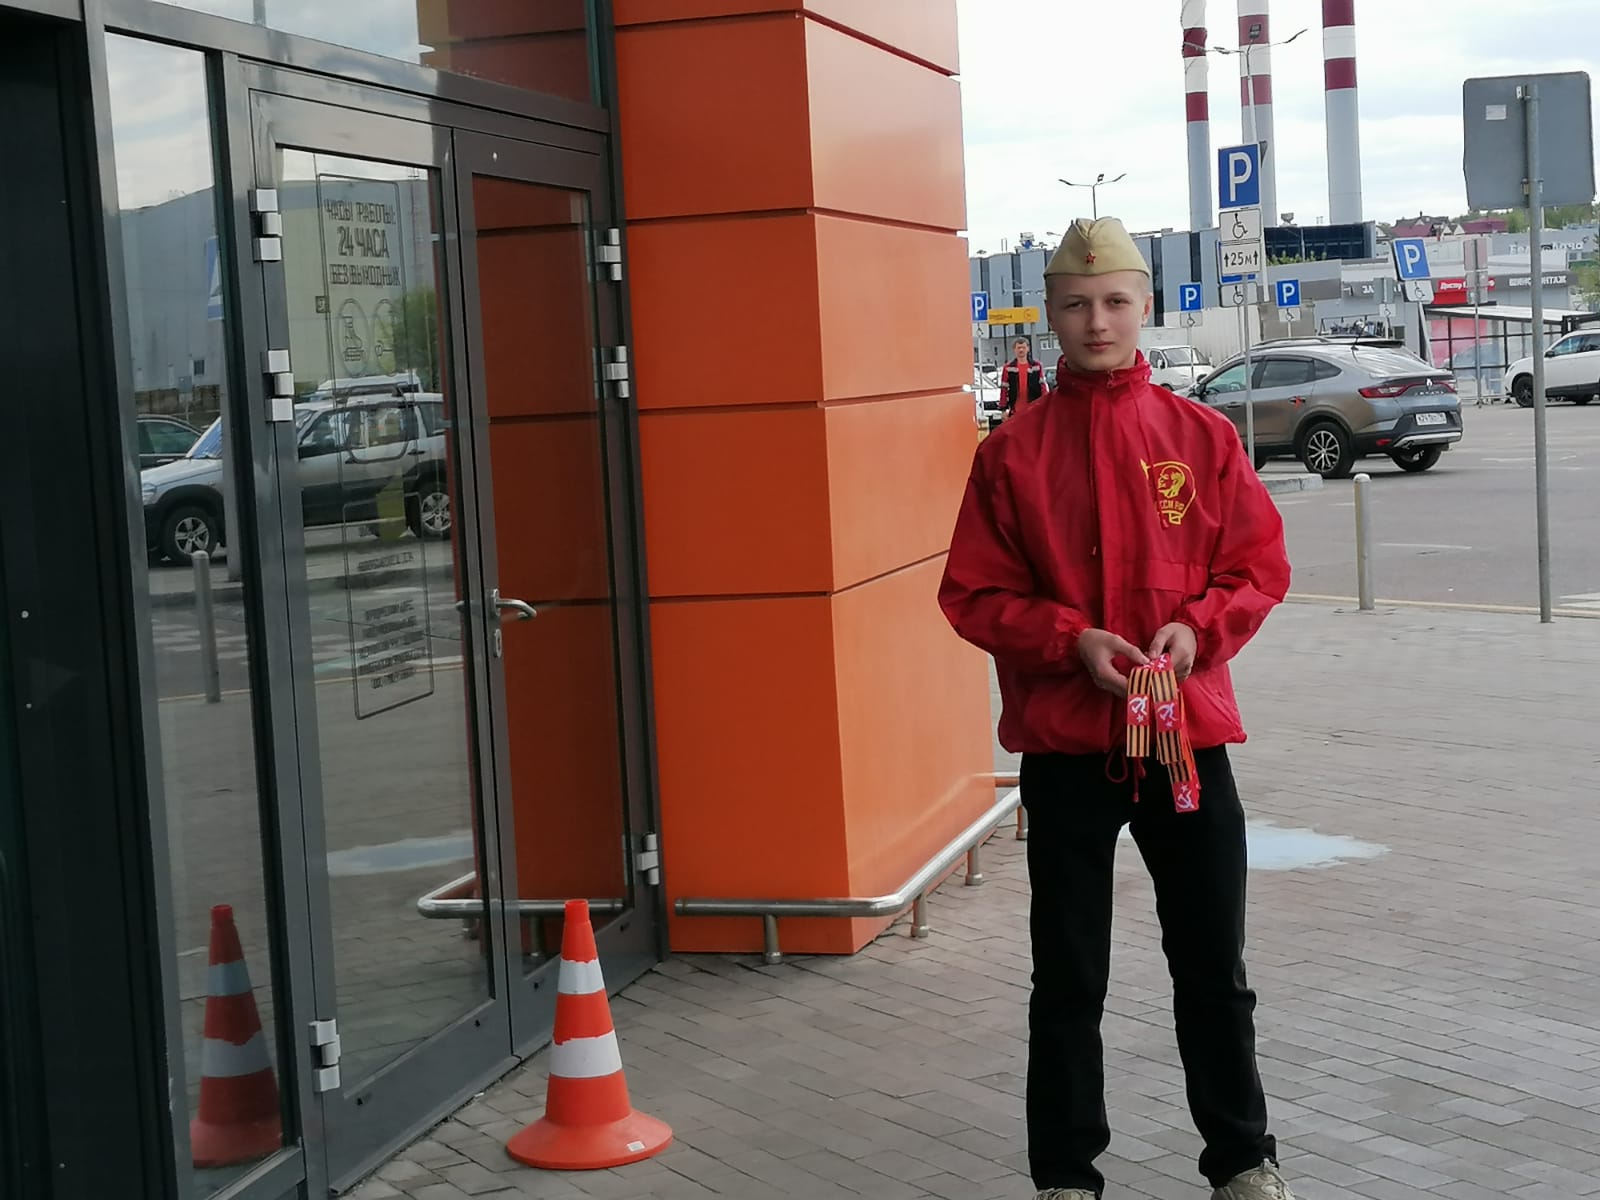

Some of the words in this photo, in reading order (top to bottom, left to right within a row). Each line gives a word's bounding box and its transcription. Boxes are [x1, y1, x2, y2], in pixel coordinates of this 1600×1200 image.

[1229, 151, 1253, 202] P
[325, 199, 354, 221] ЧАСЫ
[337, 225, 354, 256] 24
[355, 227, 390, 258] ЧАСА
[1403, 244, 1421, 274] P
[329, 263, 349, 285] БЕЗ
[349, 265, 401, 287] ВЫХОДНЫХ
[1185, 287, 1198, 309] P
[1282, 282, 1296, 304] P
[974, 296, 985, 319] P
